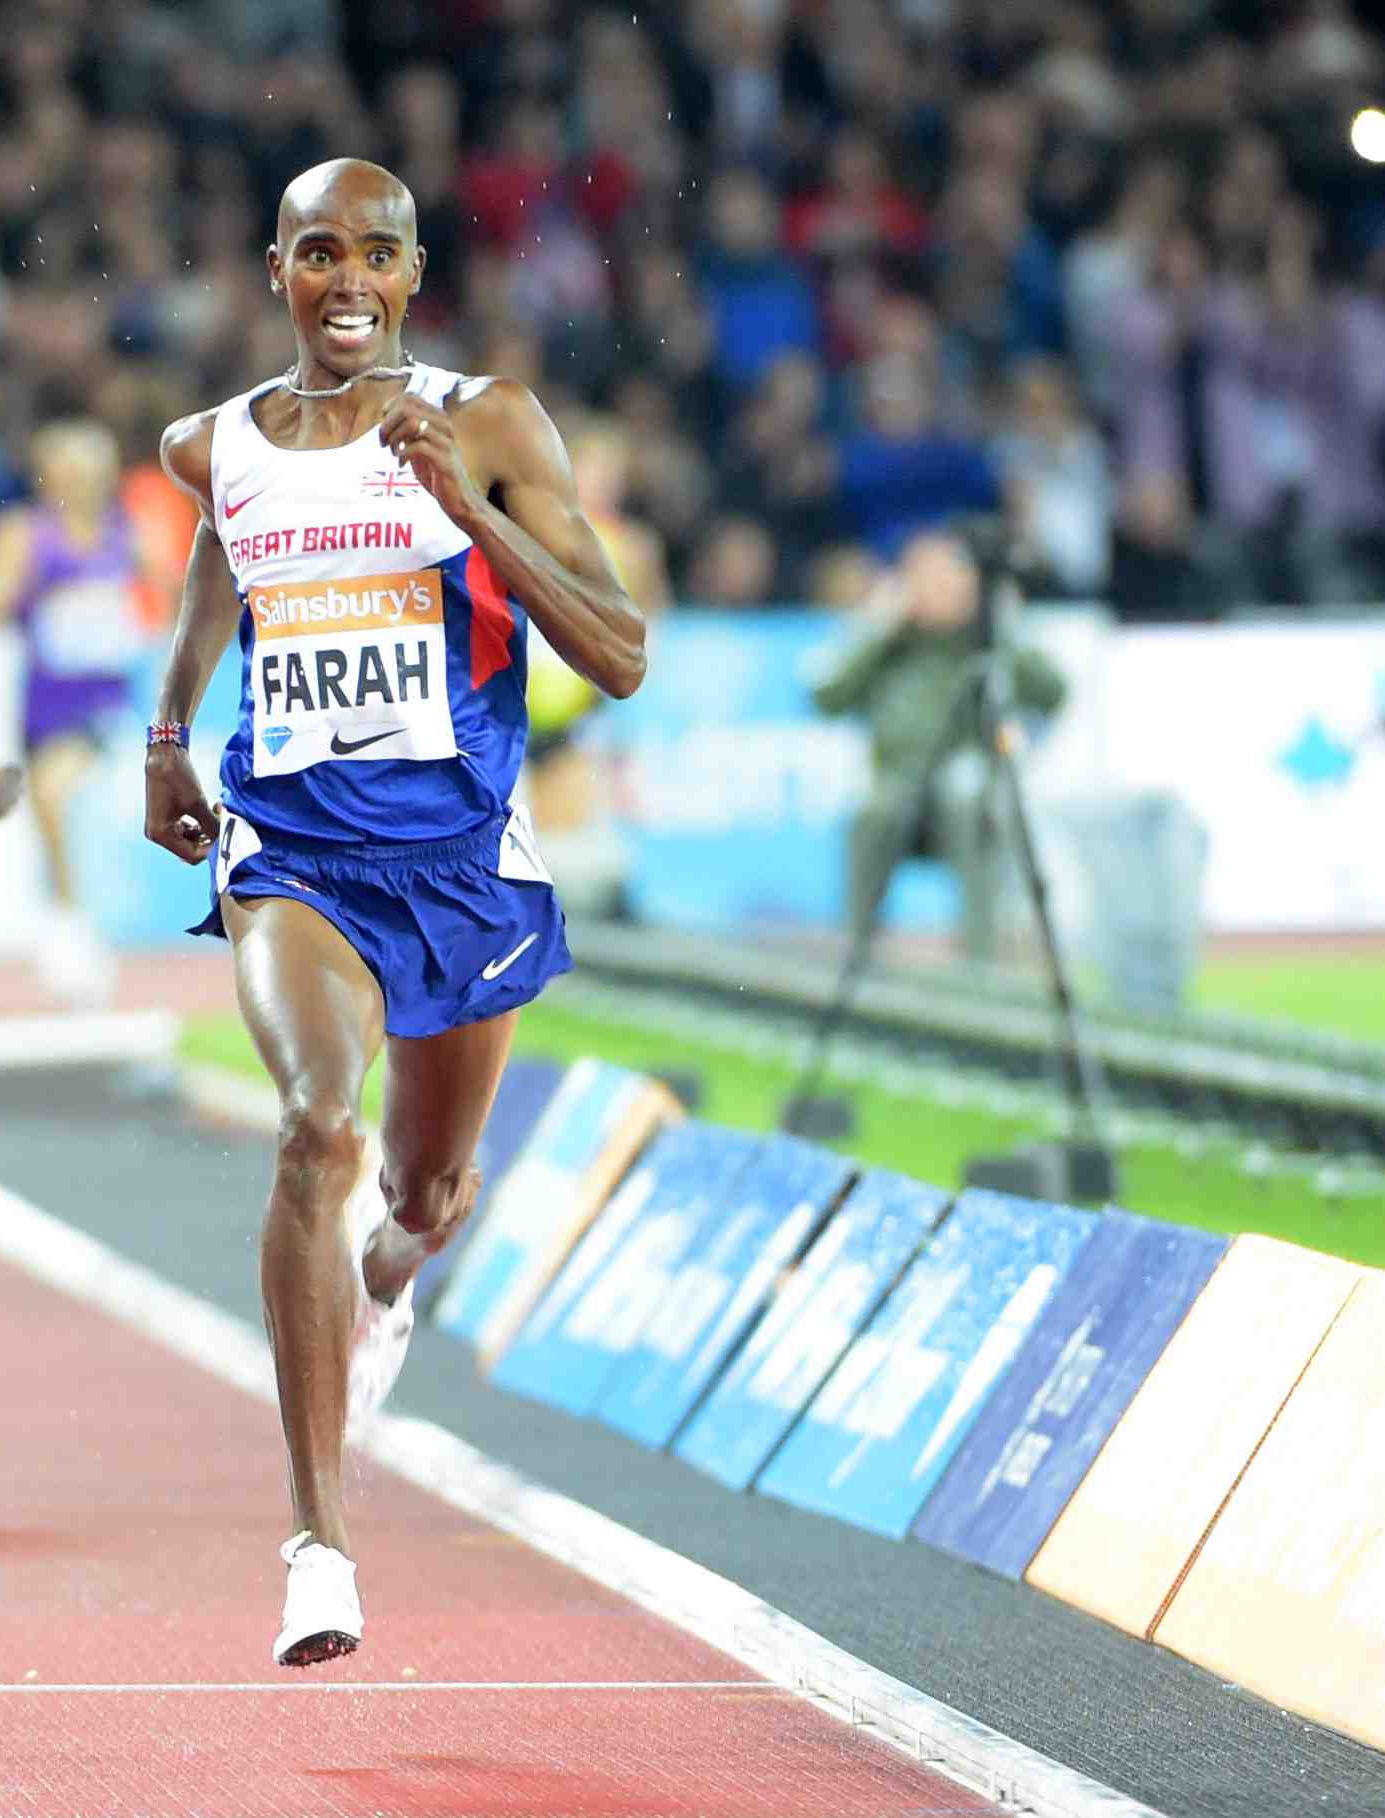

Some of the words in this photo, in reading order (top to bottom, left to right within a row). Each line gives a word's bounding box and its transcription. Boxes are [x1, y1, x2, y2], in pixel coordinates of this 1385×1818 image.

[230, 529, 296, 568] GREAT
[301, 521, 413, 552] BRITAIN
[254, 580, 432, 628] Sainsbury's
[262, 640, 430, 716] FARAH
